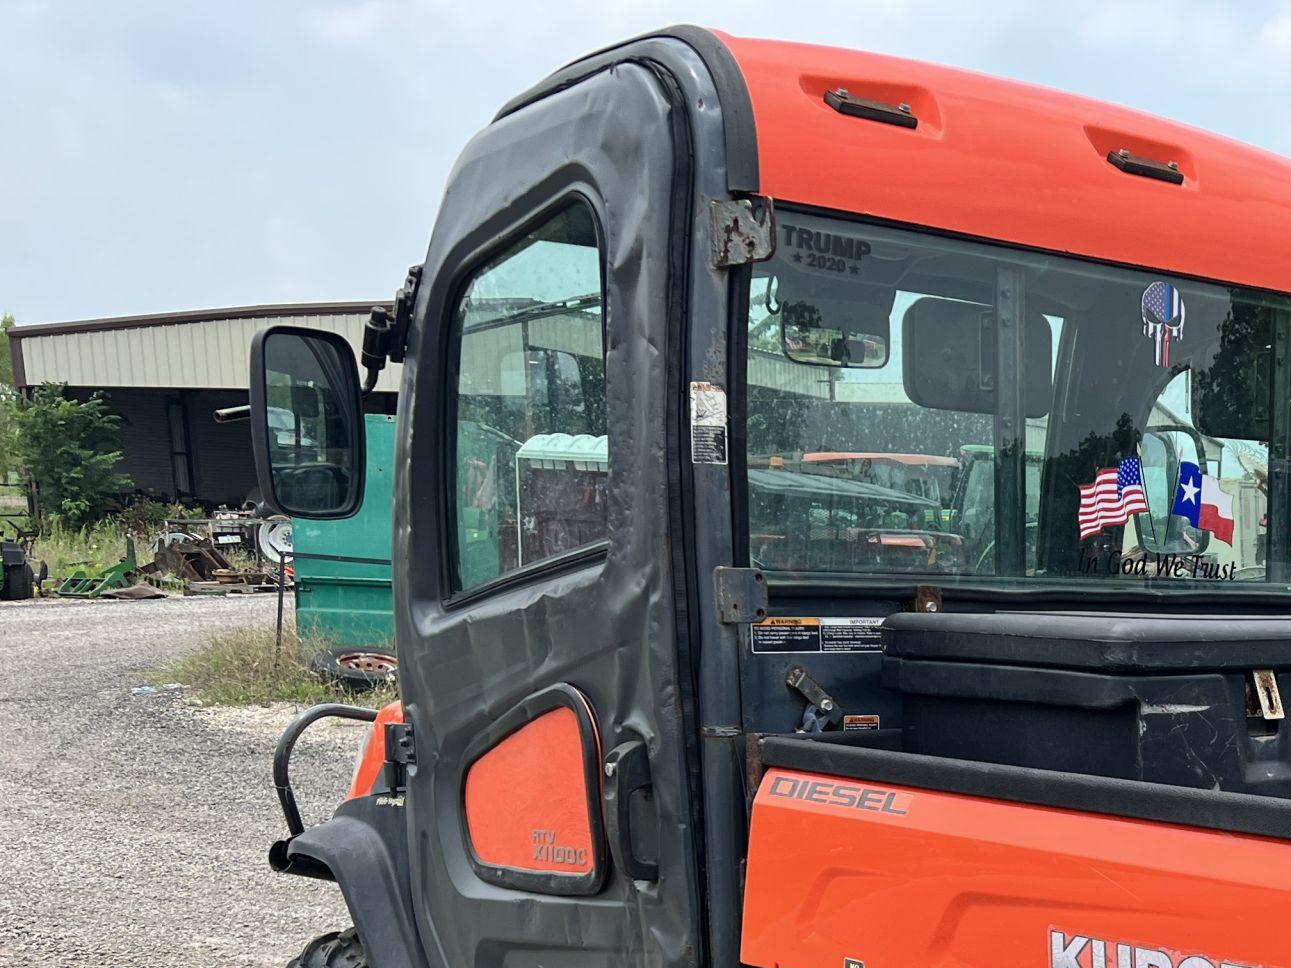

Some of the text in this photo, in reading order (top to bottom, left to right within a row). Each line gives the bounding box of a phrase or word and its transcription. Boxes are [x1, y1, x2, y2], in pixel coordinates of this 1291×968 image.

[781, 223, 872, 261] TRUMP
[805, 252, 847, 273] 2020
[1077, 548, 1237, 581] In God We Trust
[769, 776, 907, 815] DIESEL
[532, 830, 556, 845] RTV
